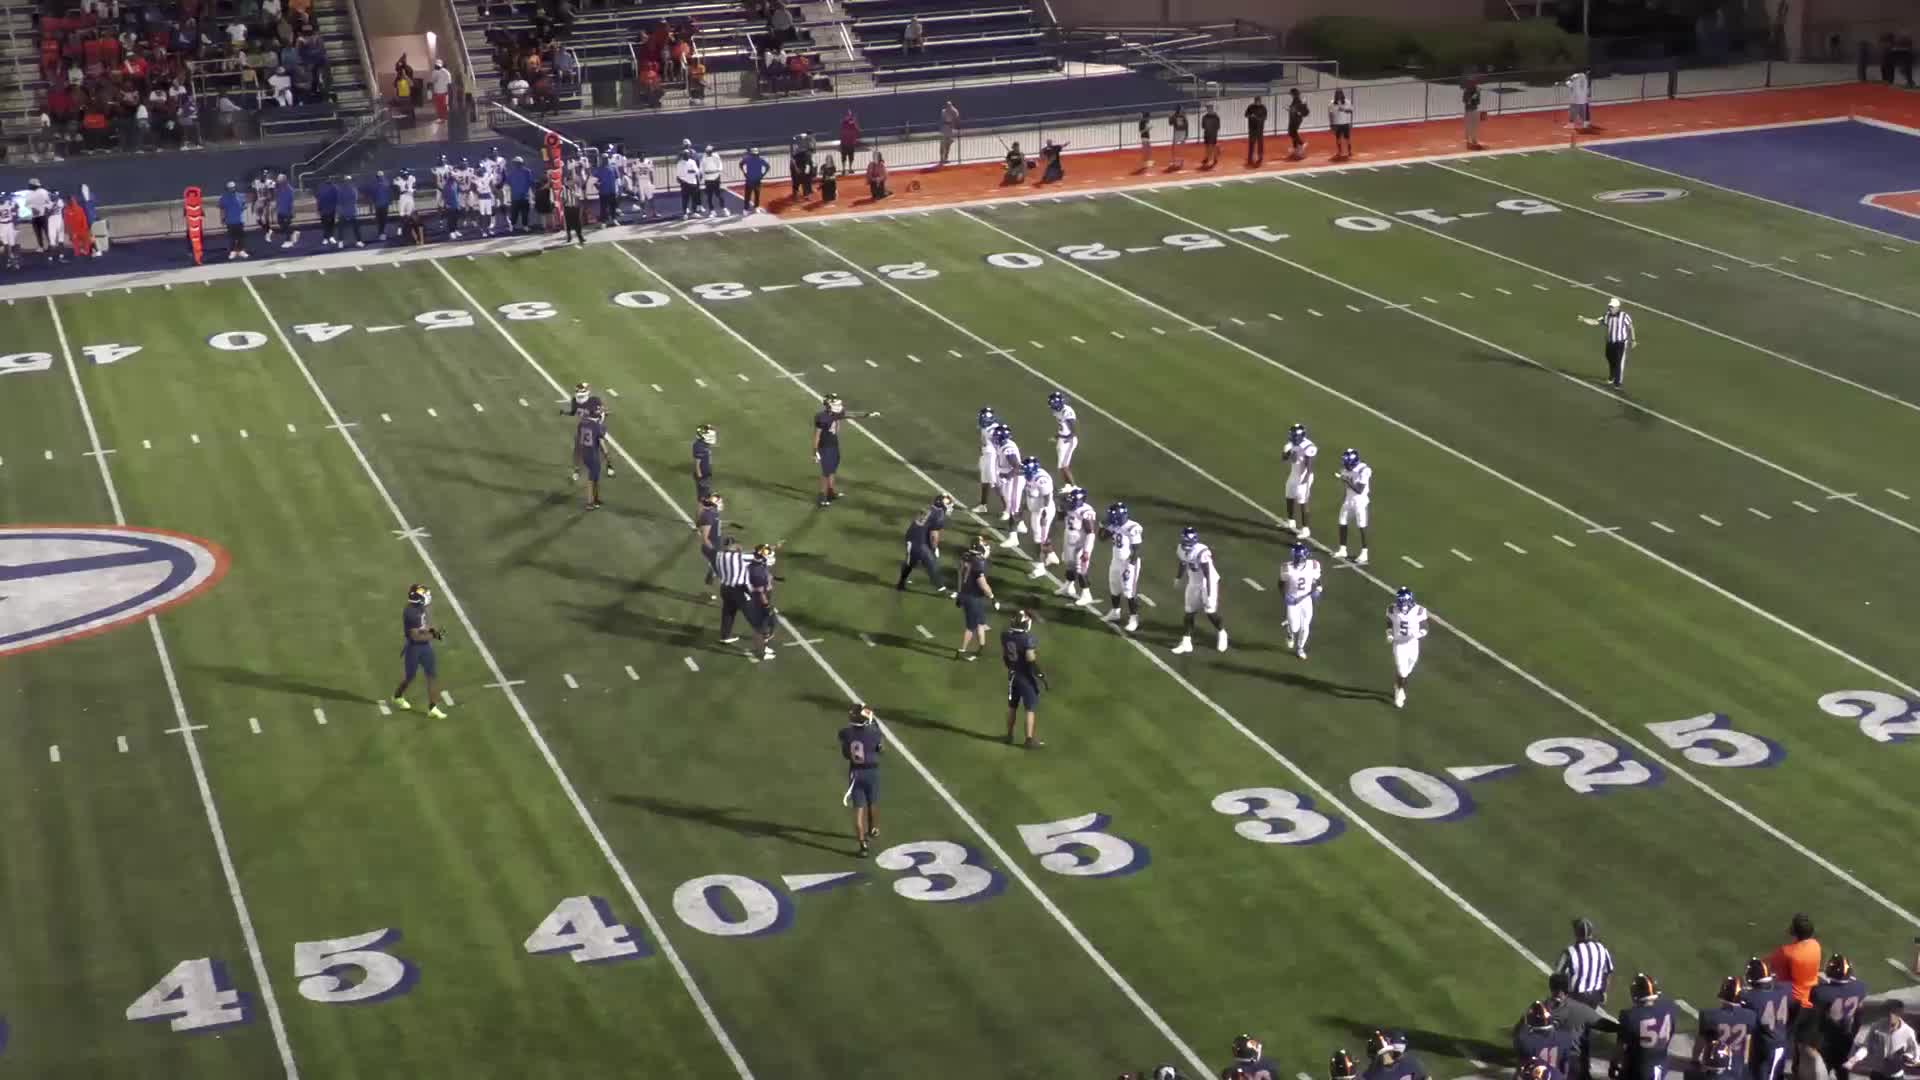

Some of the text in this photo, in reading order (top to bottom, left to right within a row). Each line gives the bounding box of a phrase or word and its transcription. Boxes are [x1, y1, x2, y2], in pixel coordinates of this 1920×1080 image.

[1496, 199, 1562, 214] 5
[1296, 577, 1306, 591] 2
[1399, 620, 1409, 637] 5
[1760, 995, 1788, 1031] 44
[1639, 1013, 1672, 1050] 54
